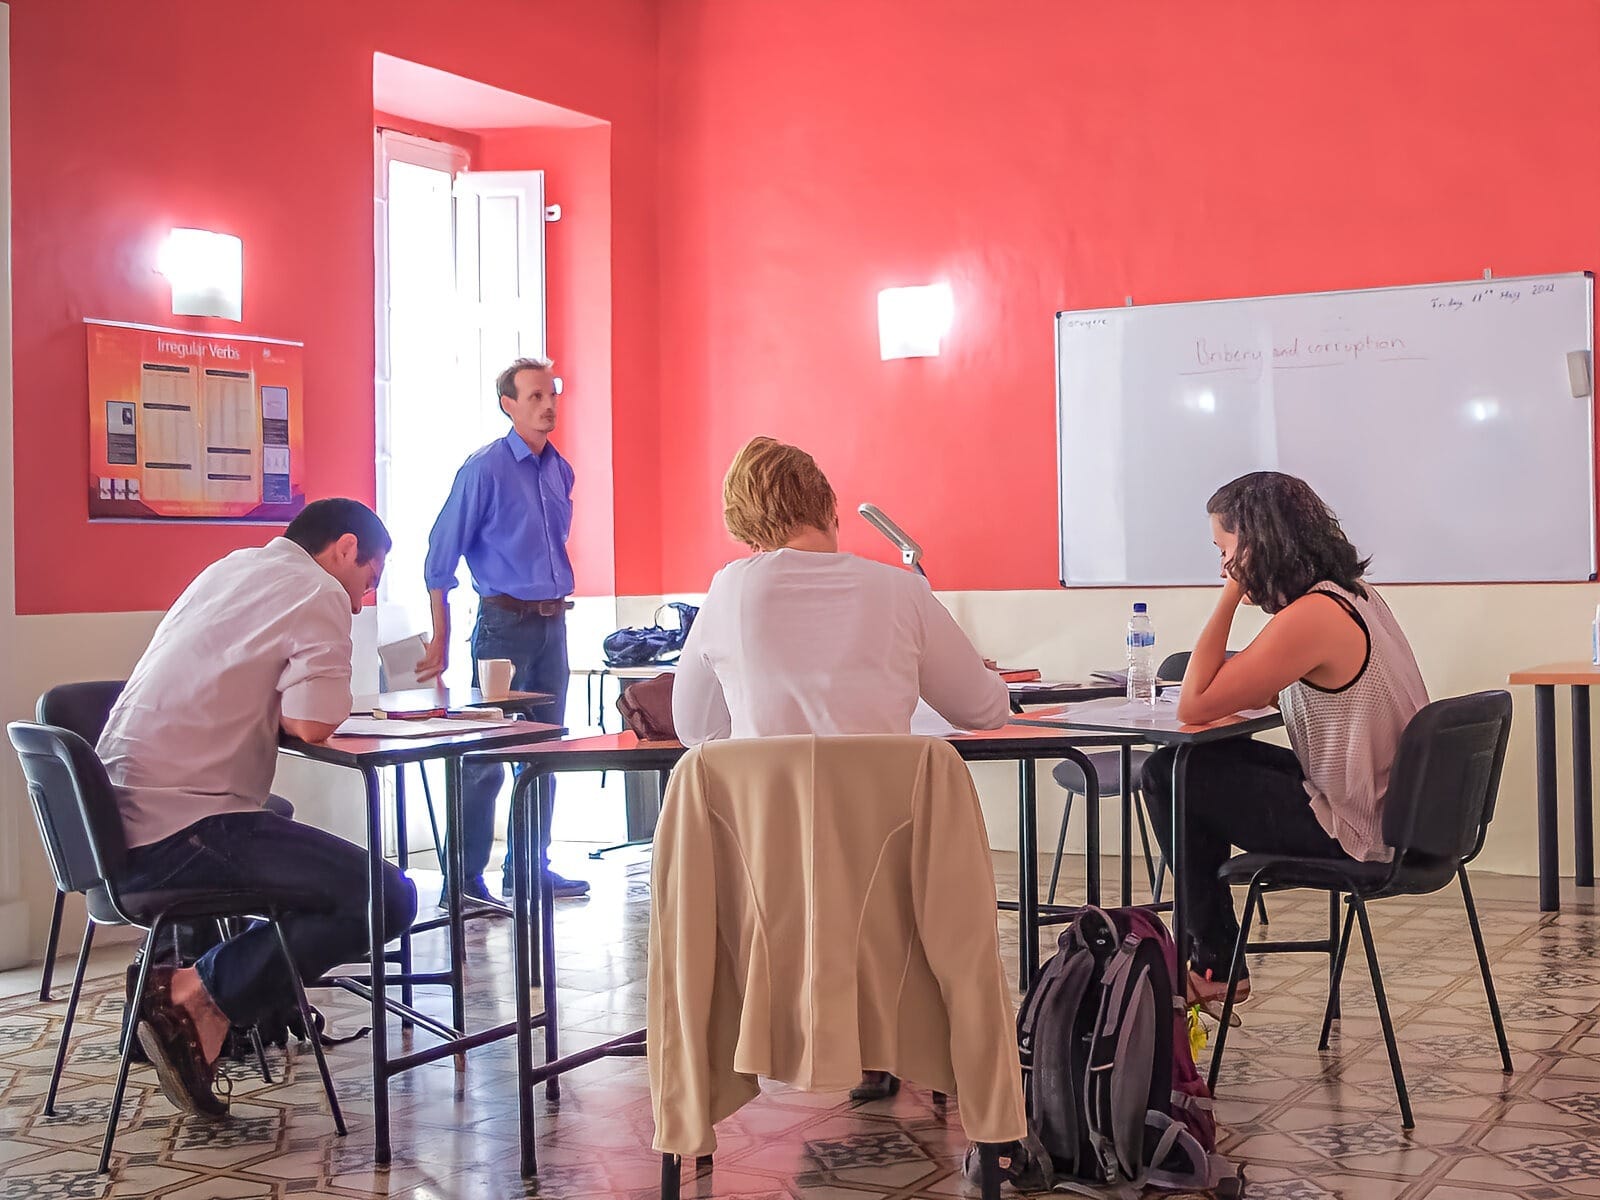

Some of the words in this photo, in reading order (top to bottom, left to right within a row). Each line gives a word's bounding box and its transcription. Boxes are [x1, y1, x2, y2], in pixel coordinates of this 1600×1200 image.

[157, 336, 206, 358] Irregular
[208, 341, 241, 361] Verbs
[1273, 337, 1299, 358] and
[1307, 335, 1407, 360] corruption
